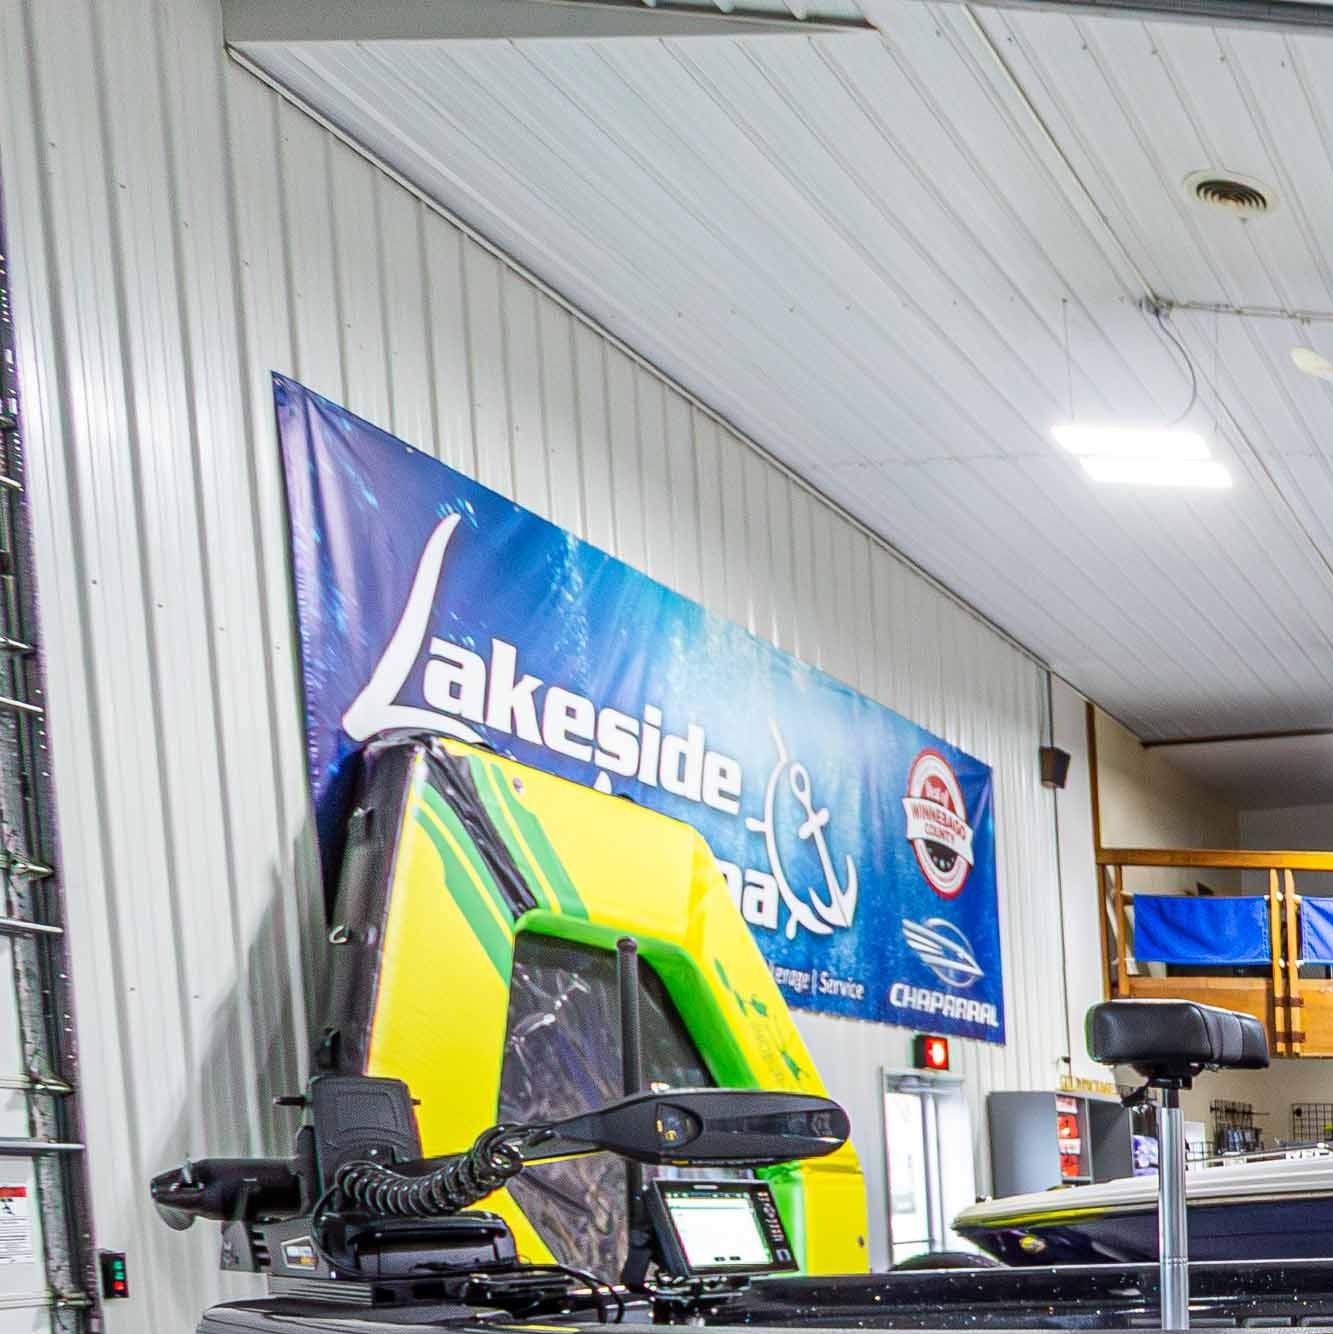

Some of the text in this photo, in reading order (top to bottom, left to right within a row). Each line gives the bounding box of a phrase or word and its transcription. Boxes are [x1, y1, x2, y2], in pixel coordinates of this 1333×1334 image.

[342, 513, 742, 816] Lakeside
[818, 970, 864, 1000] Service
[889, 982, 999, 1027] CHAPARRAL
